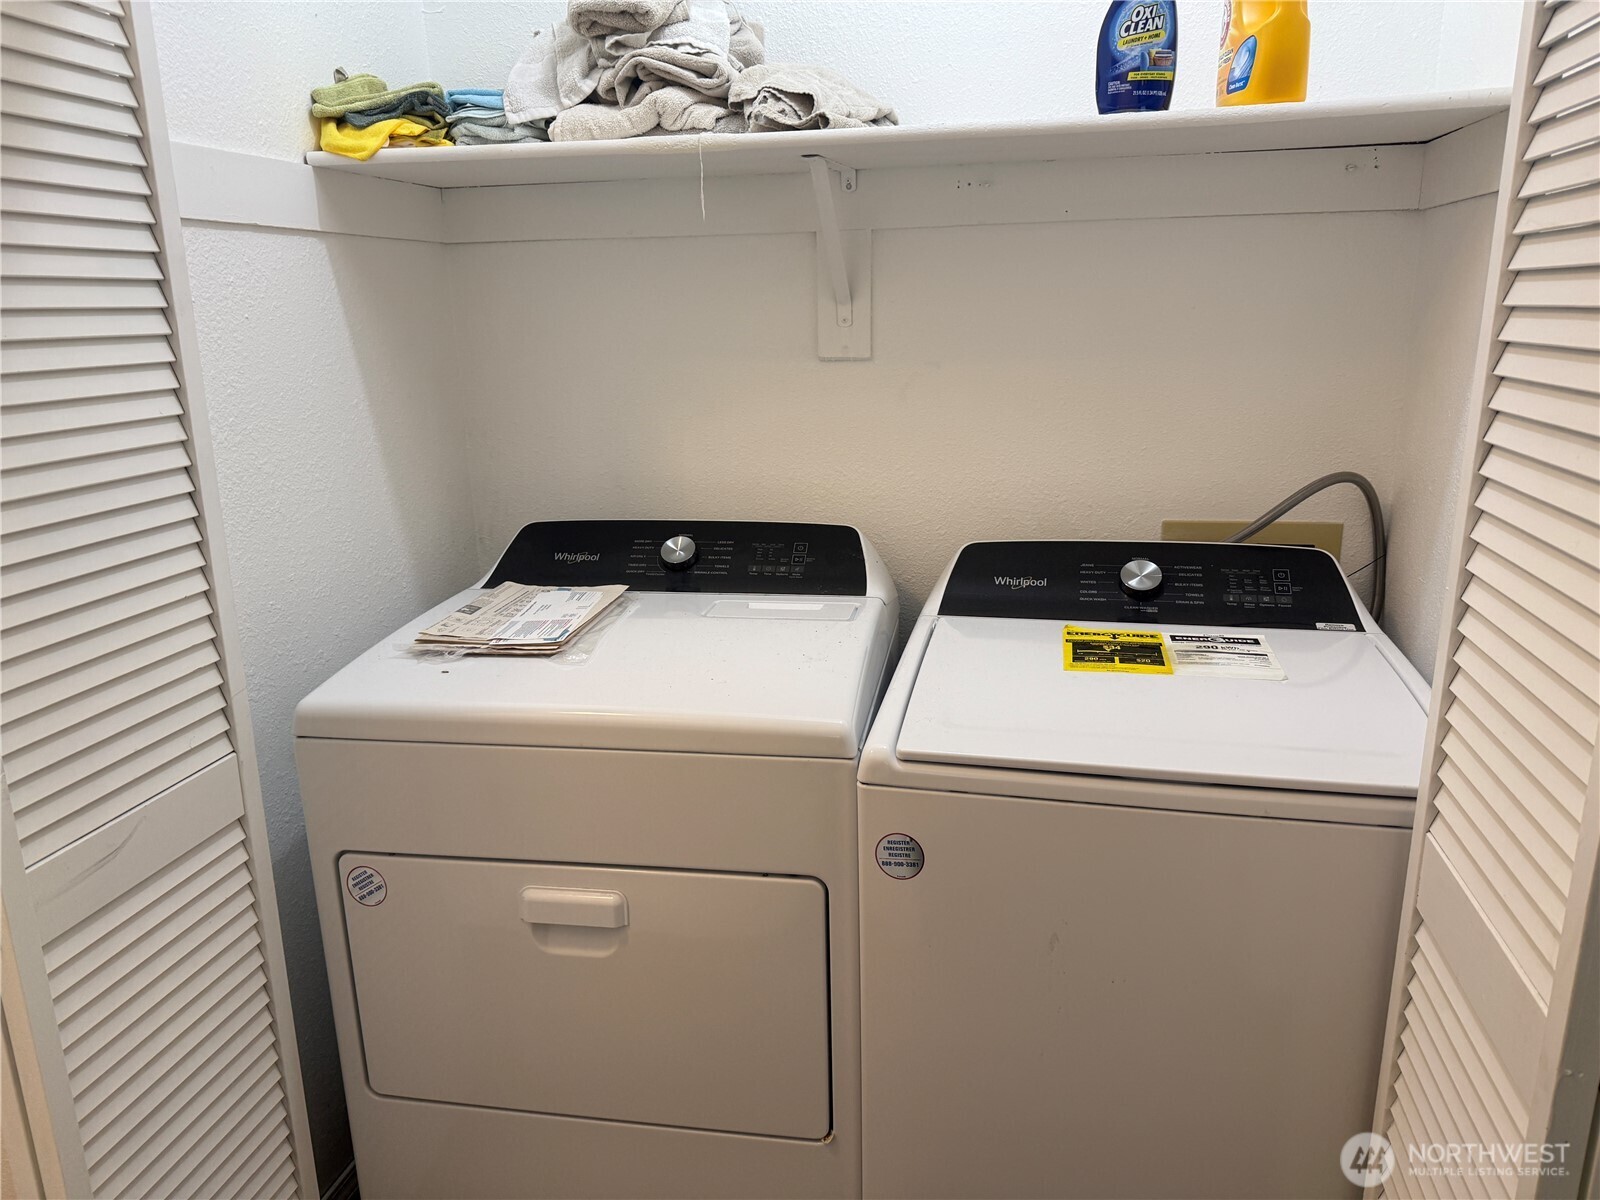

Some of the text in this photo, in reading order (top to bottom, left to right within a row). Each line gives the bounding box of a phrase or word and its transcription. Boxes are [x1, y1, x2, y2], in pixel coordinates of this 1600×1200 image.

[1131, 4, 1158, 23] OXI
[1119, 15, 1164, 38] CLEAN
[1148, 32, 1161, 40] HOME
[554, 552, 600, 563] Whirlpool
[994, 576, 1047, 588] Whirlpool
[352, 870, 367, 881] REGISTER
